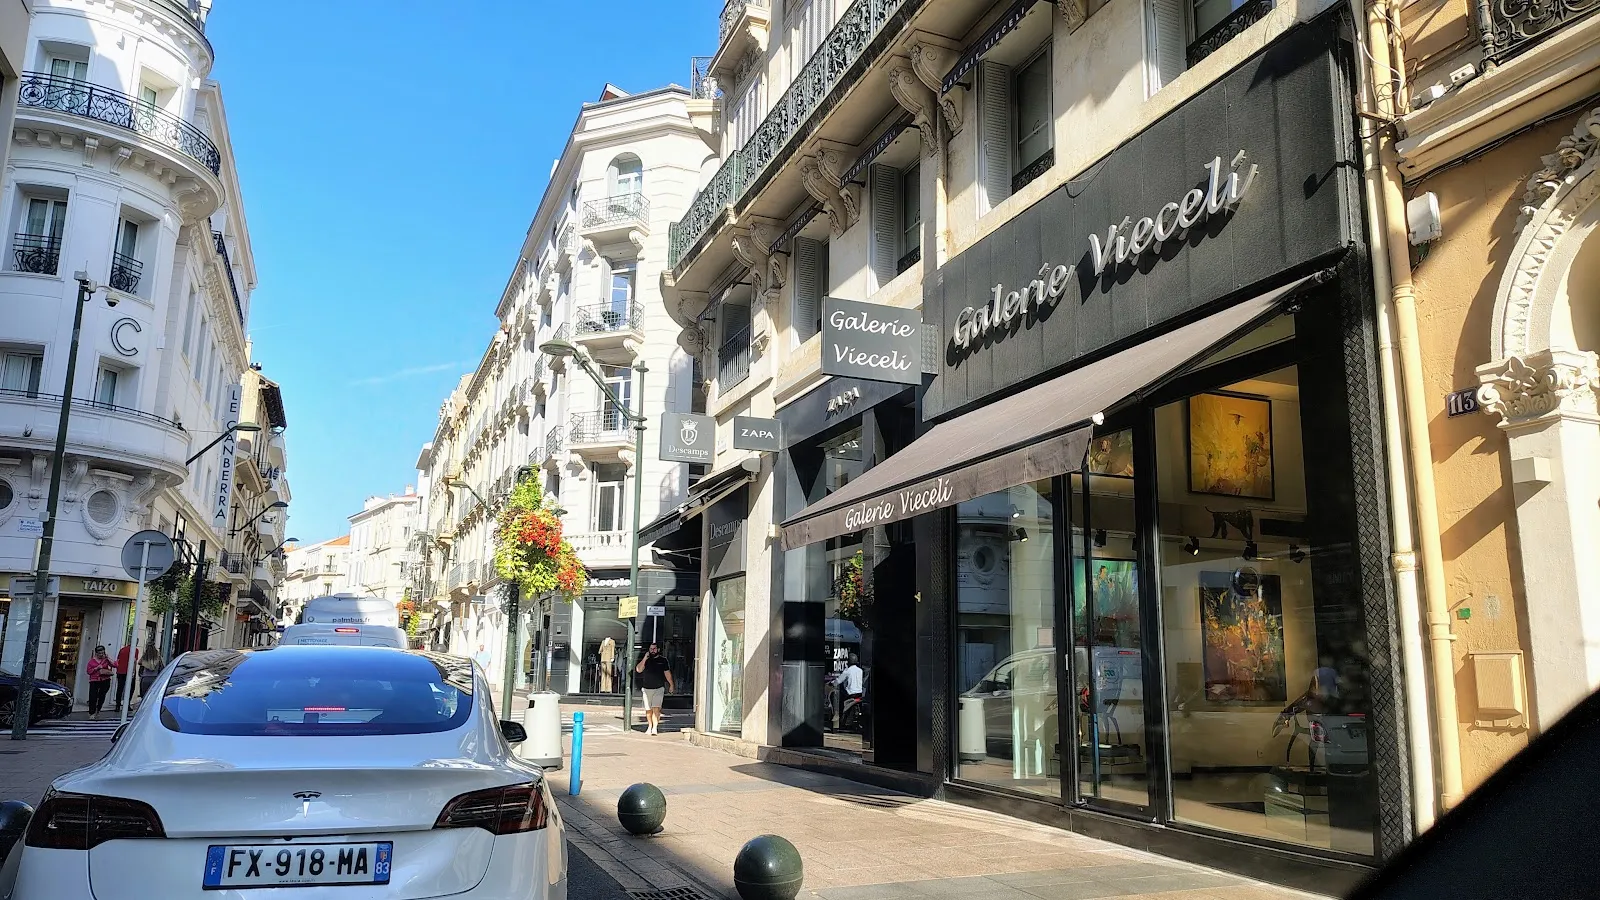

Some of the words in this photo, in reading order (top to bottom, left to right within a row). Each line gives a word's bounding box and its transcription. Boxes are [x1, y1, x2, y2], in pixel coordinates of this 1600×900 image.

[942, 52, 980, 92] GALERIE
[984, 7, 1025, 50] VIECELI
[953, 262, 1076, 348] Galerie
[1088, 149, 1259, 277] Vieceli
[111, 317, 142, 356] C
[829, 310, 916, 337] Galerie
[833, 343, 912, 371] Vieceli
[229, 390, 238, 413] LE
[827, 386, 859, 412] ZAPA
[1450, 391, 1475, 414] 113
[741, 428, 774, 439] ZAPA
[668, 444, 709, 457] Descamps
[215, 420, 237, 519] CANBERRA
[845, 499, 895, 531] Galerie
[900, 478, 953, 514] Vieceli
[82, 580, 118, 592] TAIZO
[589, 578, 632, 588] Koople
[332, 616, 370, 624] palmbus.fr
[833, 647, 849, 660] ZAPA
[210, 867, 217, 875] F
[227, 848, 368, 878] FX-918-MA
[375, 861, 390, 875] 83
